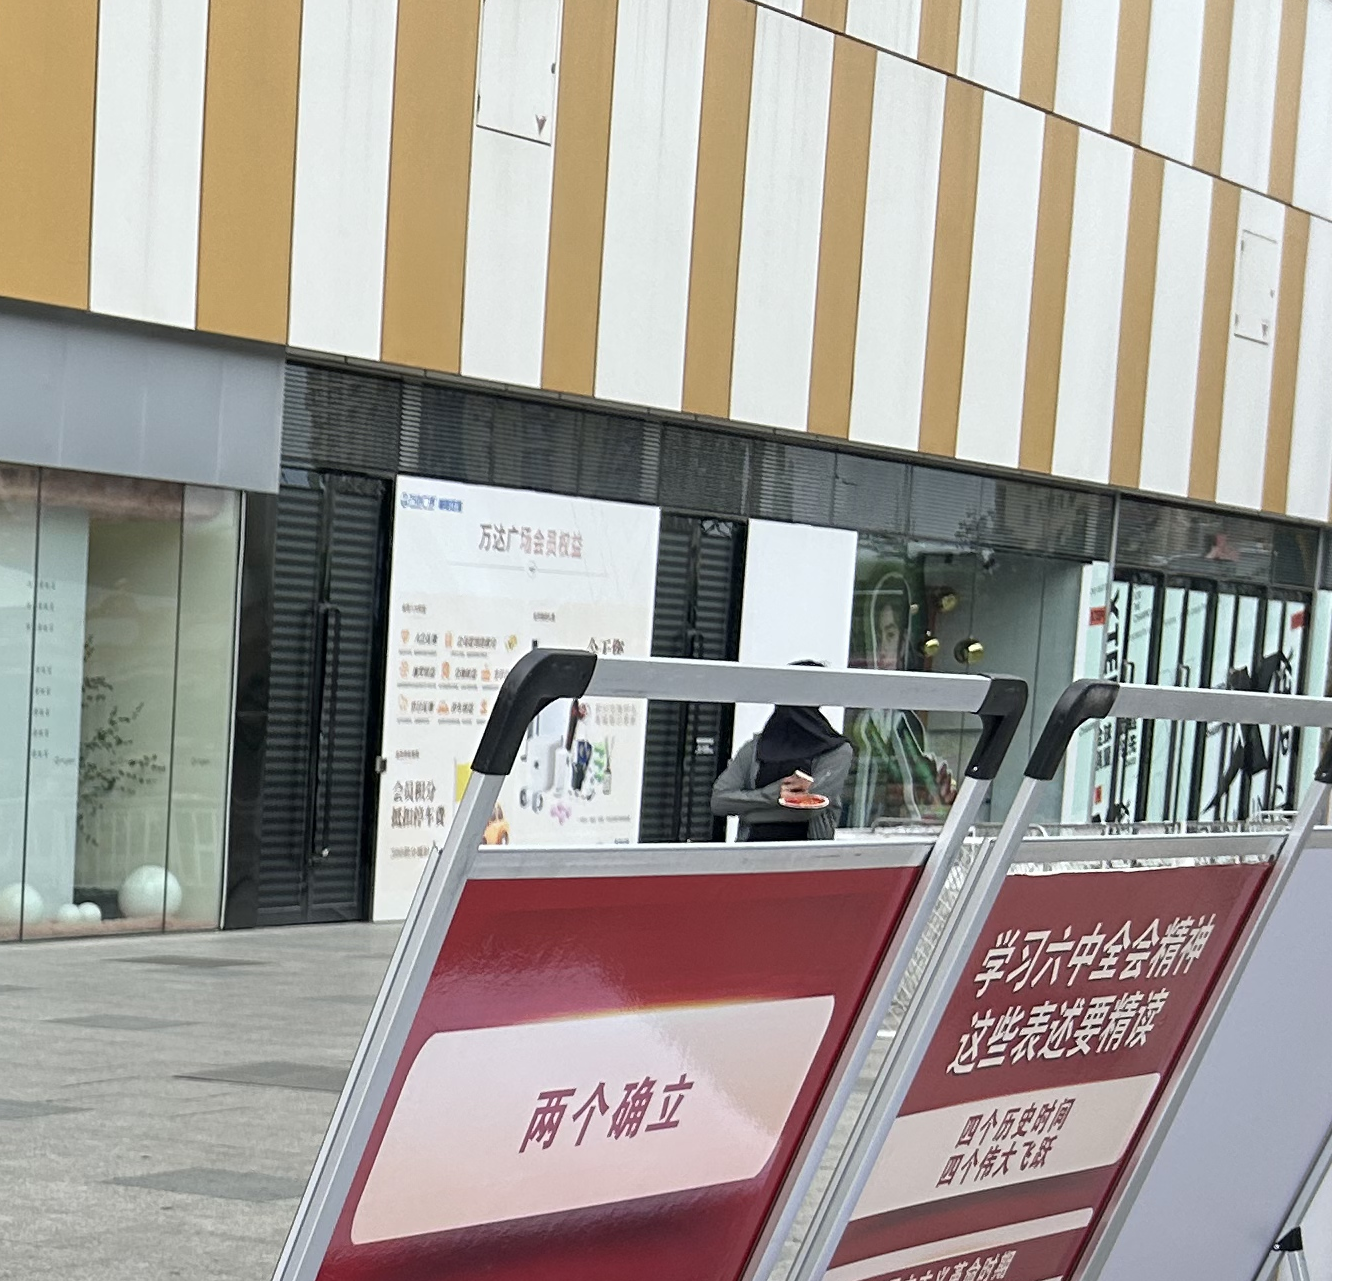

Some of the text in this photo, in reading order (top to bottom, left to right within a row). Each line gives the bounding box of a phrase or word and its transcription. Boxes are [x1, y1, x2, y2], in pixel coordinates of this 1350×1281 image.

[478, 524, 584, 558] 万达广场会员权益
[973, 912, 1216, 999] 学习六中全会精神
[946, 988, 1169, 1075] 这些表述要精读
[518, 1073, 695, 1154] 两个确立
[956, 1098, 1076, 1149] 四个历史时间
[935, 1135, 1058, 1189] 四个伟大飞跃
